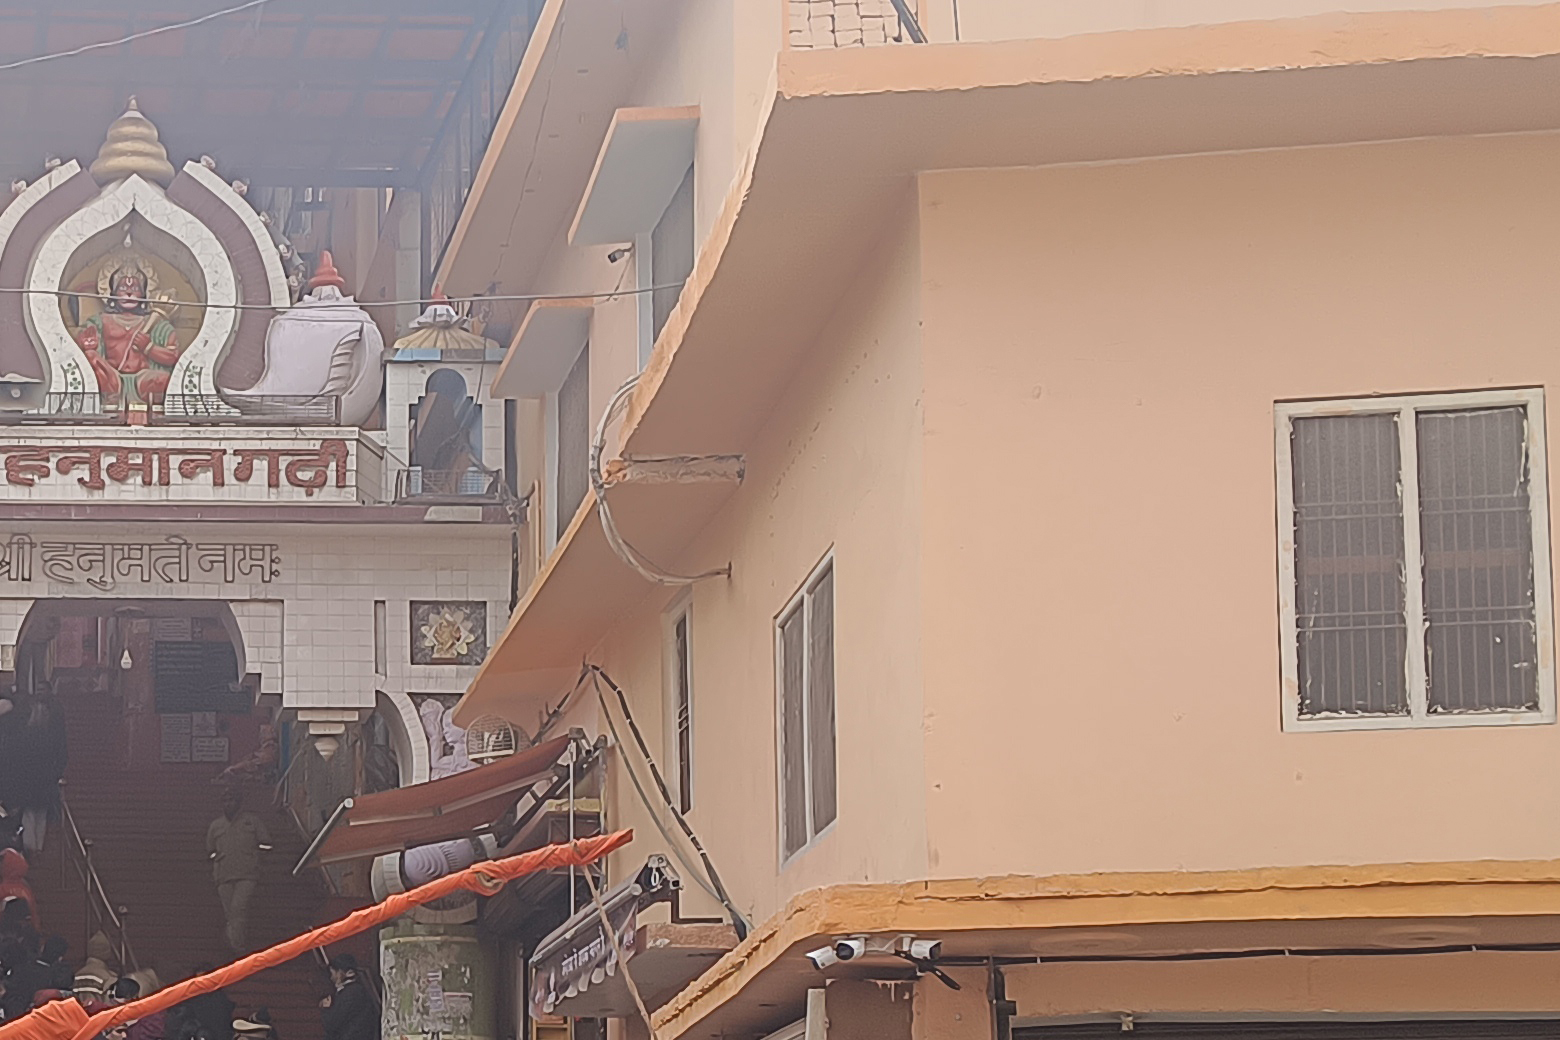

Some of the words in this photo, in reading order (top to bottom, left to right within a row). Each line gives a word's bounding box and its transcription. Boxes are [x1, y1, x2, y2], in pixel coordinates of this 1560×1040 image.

[233, 439, 349, 496] गढ़ी
[40, 534, 193, 591] हनुमते
[195, 543, 281, 584] नमः
